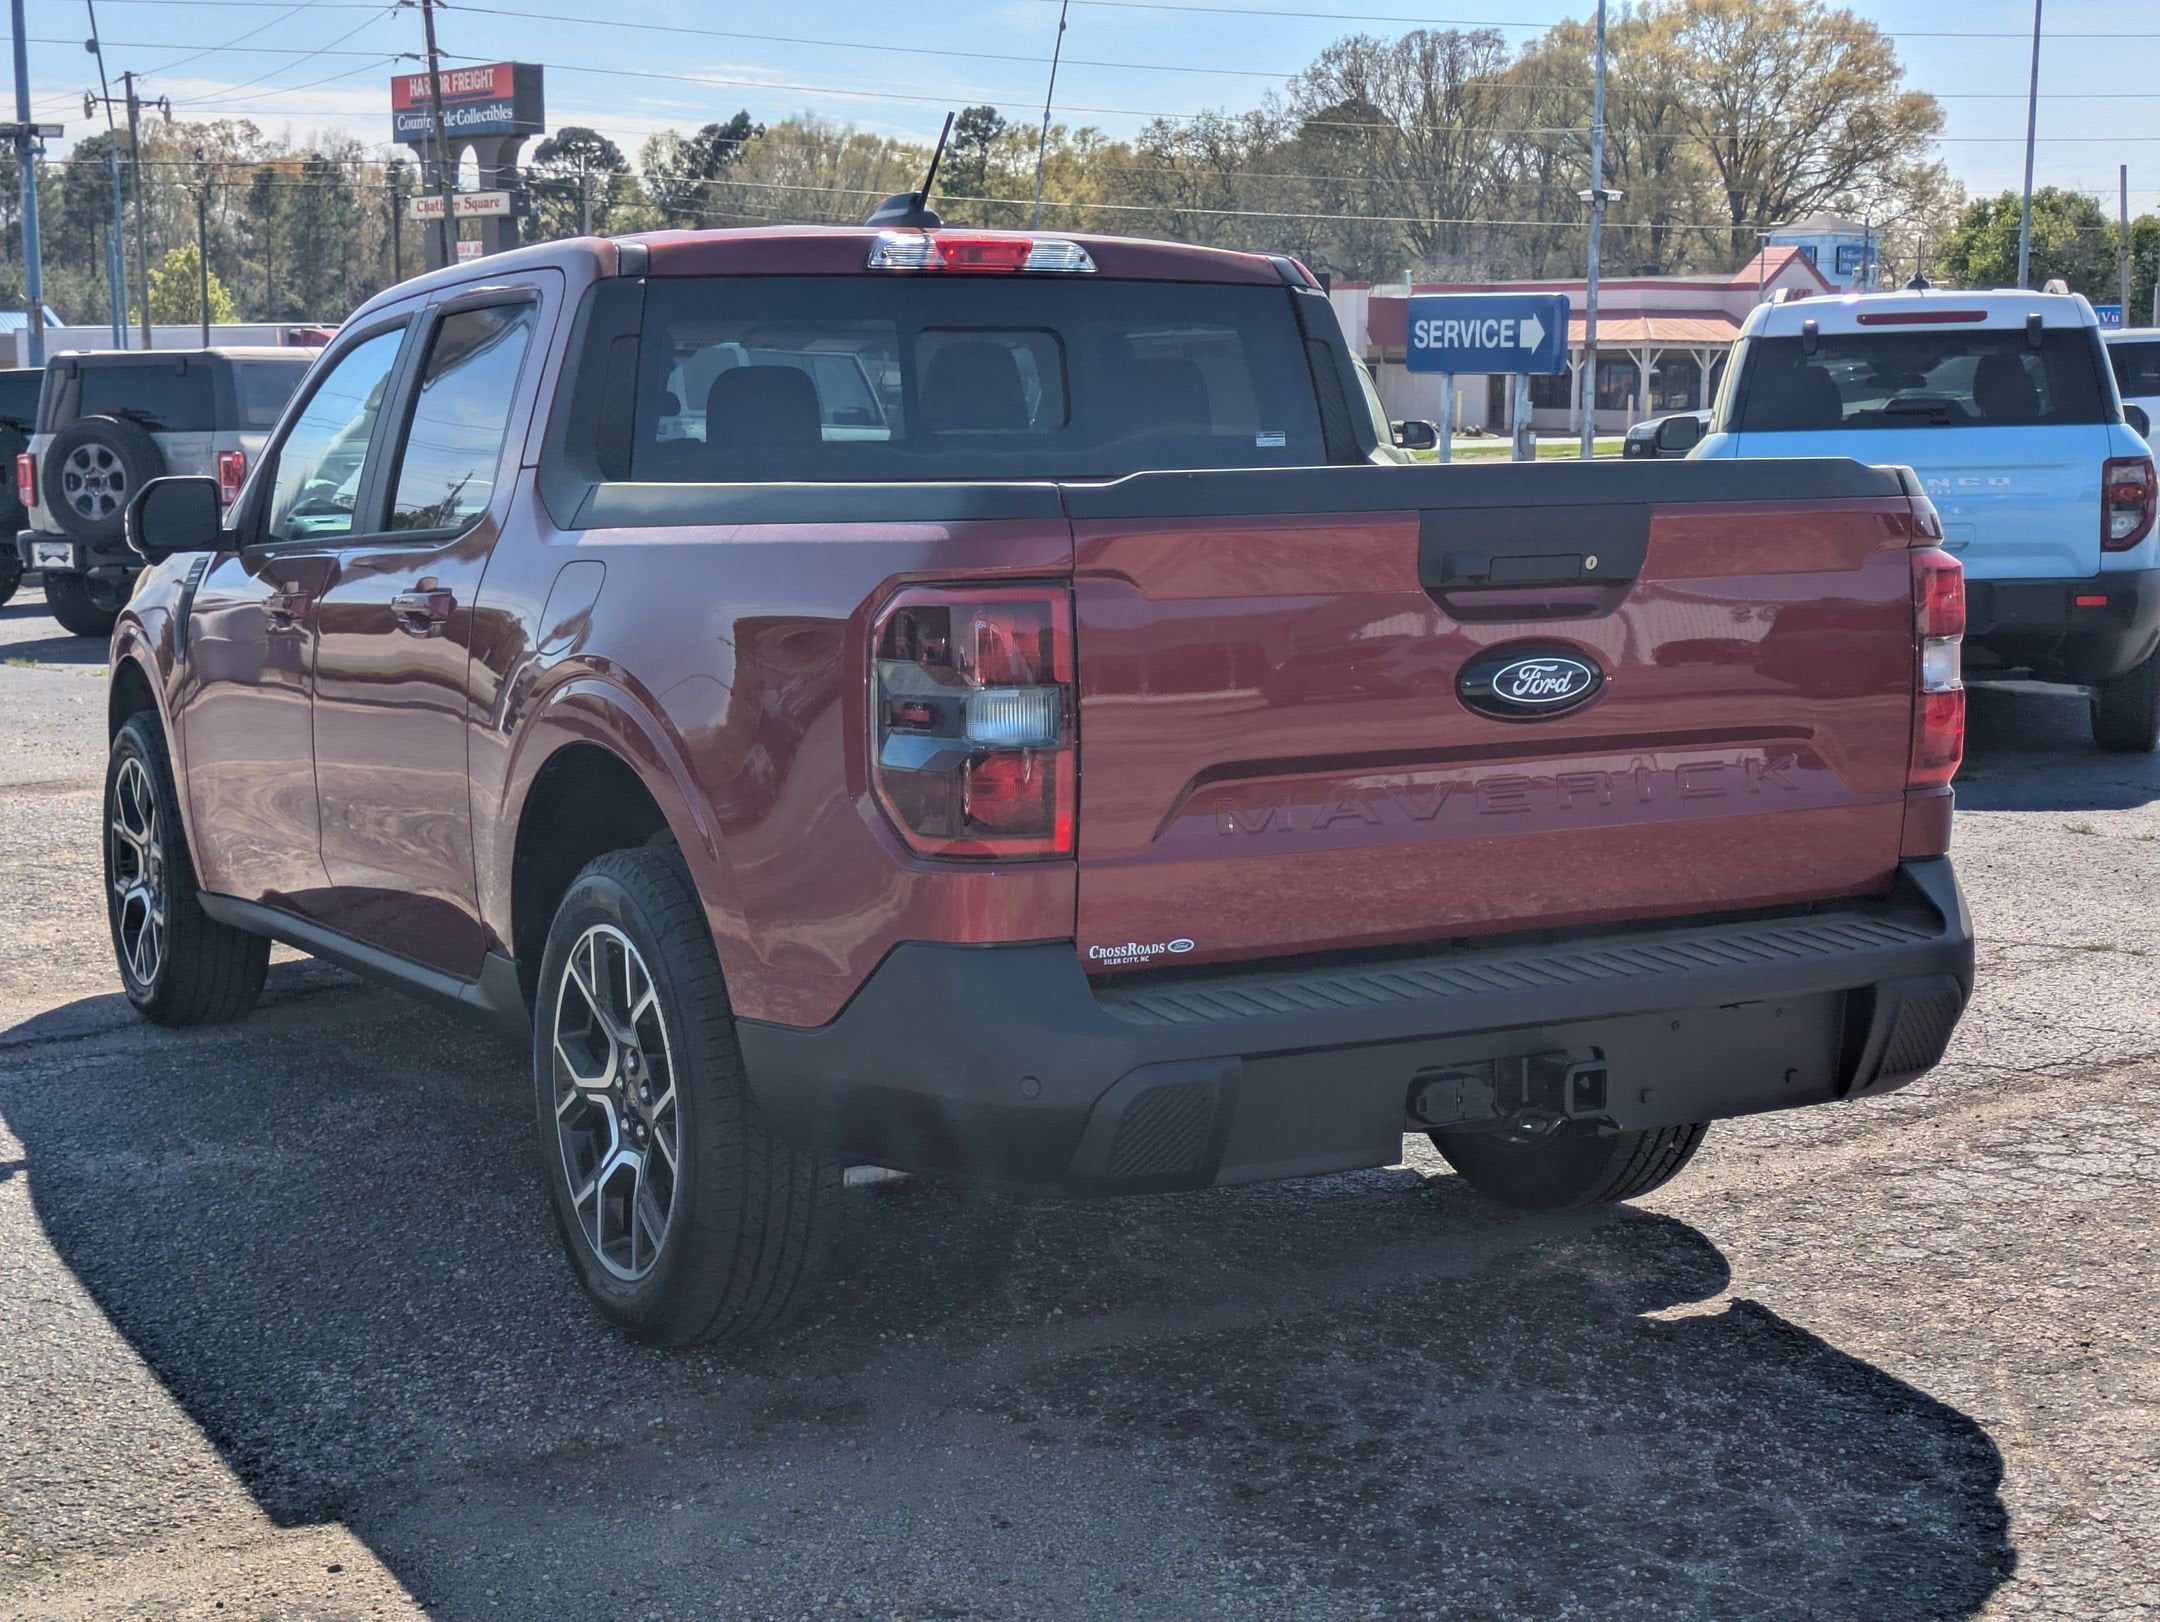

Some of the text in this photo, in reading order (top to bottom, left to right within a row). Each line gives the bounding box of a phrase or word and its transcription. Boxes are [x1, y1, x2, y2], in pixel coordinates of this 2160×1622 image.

[409, 69, 494, 97] HAROR FREIGHT
[456, 104, 513, 126] Collectibles
[416, 197, 500, 213] Chathm Square
[1413, 319, 1515, 349] SERVICE
[1512, 664, 1573, 696] Ford
[1214, 753, 1799, 837] MAVERICK
[1103, 957, 1122, 966] SILER
